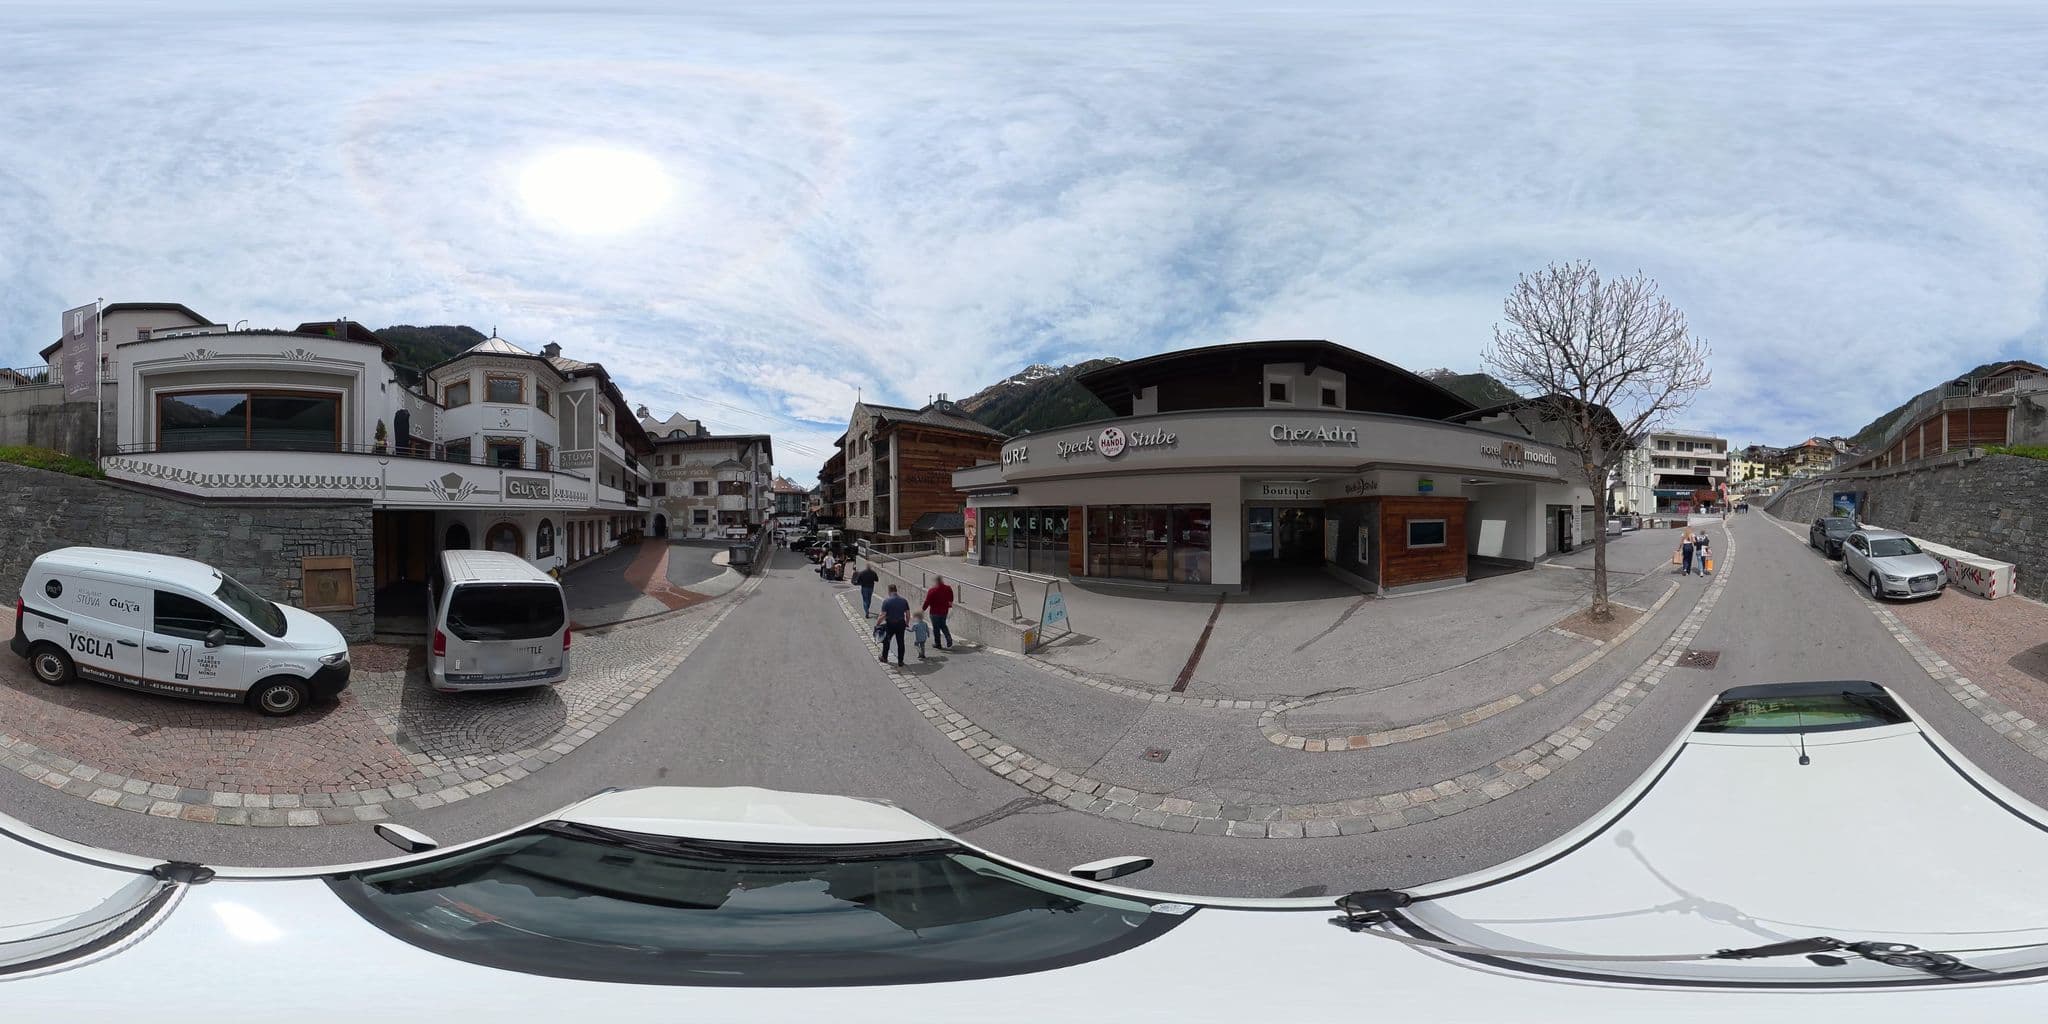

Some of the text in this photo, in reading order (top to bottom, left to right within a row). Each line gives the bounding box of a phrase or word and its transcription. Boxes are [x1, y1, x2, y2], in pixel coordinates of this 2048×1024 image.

[1101, 437, 1124, 447] HANDL
[1128, 427, 1176, 447] Stube
[1269, 424, 1357, 443] Chez Adri
[1056, 436, 1094, 458] Speck
[1524, 450, 1557, 465] mondin
[1263, 485, 1312, 499] Boutique
[988, 516, 1070, 531] BAKERY
[69, 633, 114, 660] YSCLA
